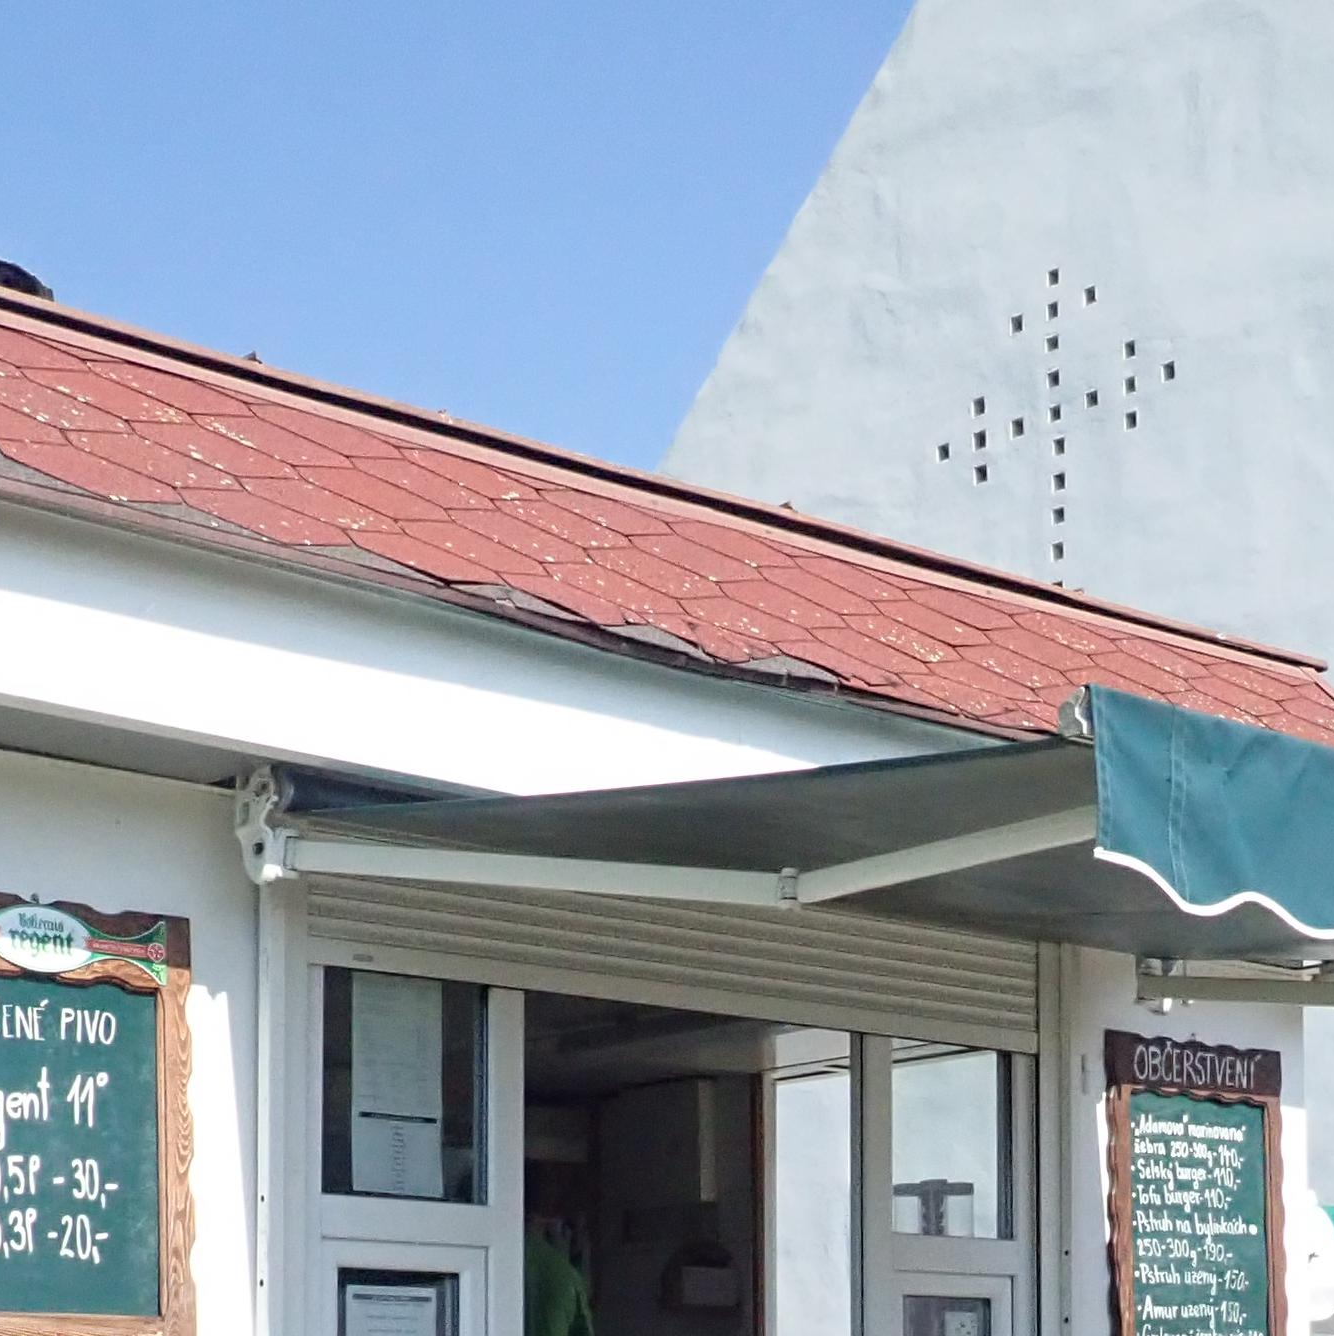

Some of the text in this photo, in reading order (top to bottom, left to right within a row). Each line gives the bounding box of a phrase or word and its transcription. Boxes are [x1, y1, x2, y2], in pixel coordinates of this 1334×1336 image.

[60, 1007, 116, 1045] PIVO
[1133, 1041, 1262, 1089] OBČERSTVENÍ
[1136, 1184, 1162, 1205] Tofu
[1136, 1209, 1173, 1233] Pstruh
[1176, 1219, 1192, 1234] na
[1139, 1263, 1181, 1284] Pstruh
[1142, 1295, 1178, 1320] Amur
